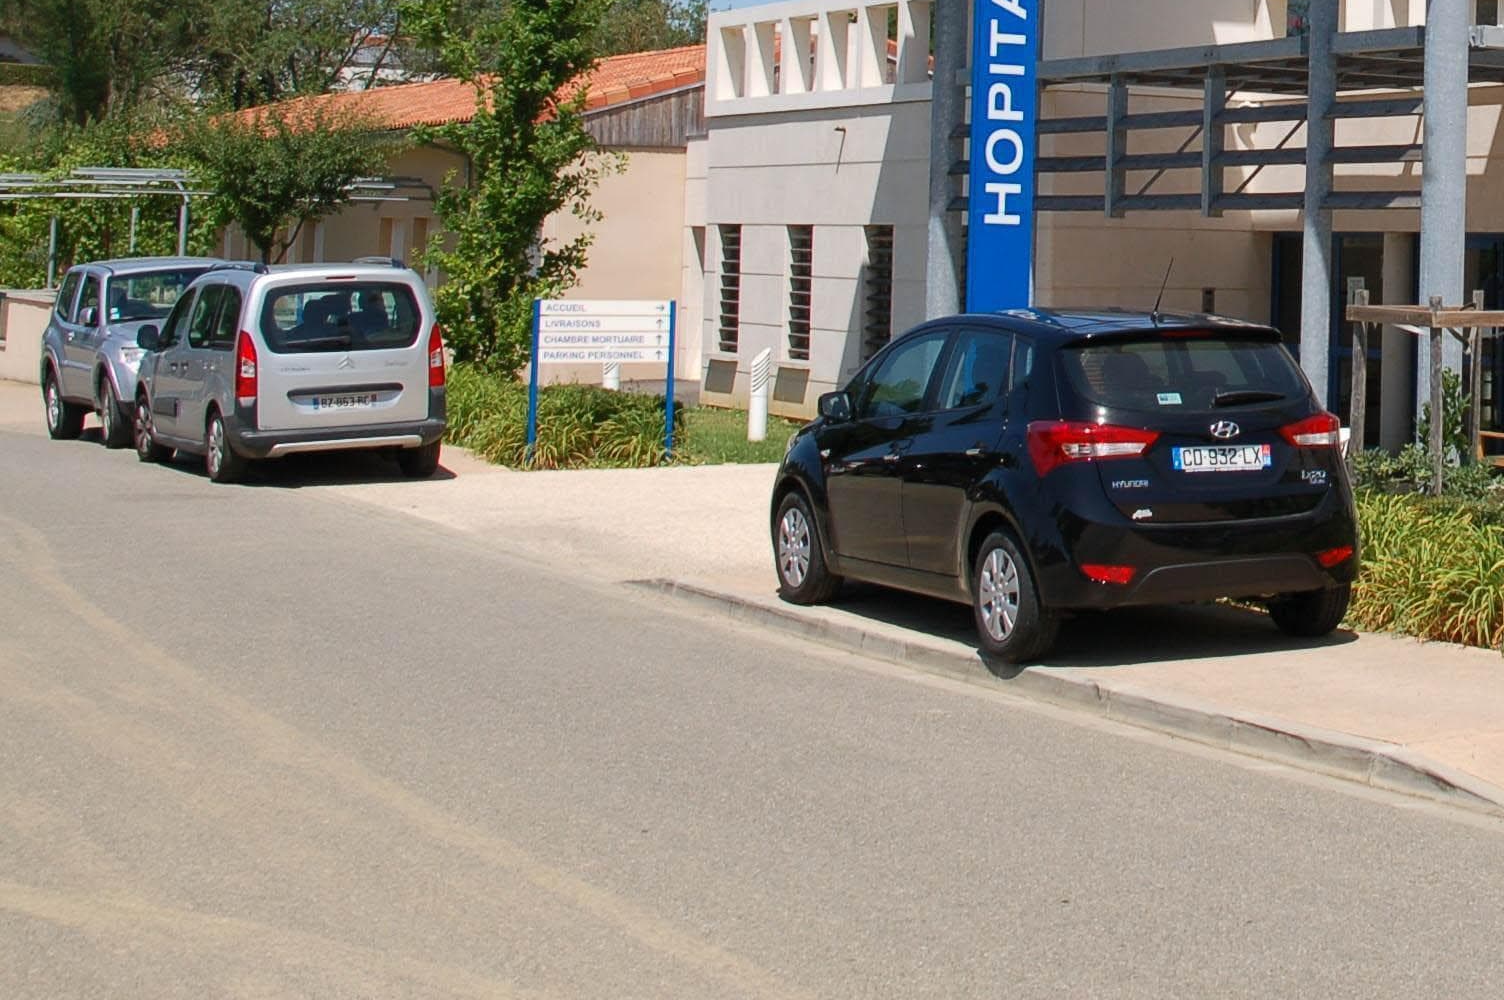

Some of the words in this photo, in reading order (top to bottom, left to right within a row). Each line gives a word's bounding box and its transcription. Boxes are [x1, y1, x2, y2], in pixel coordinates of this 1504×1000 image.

[545, 303, 587, 313] ACCUEIL
[545, 319, 601, 329] LIVRAISONS
[544, 335, 588, 344] CHAMBRE
[592, 335, 645, 344] MORTUAIRE
[543, 351, 585, 360] PARKING
[588, 351, 645, 360] PERSONNEL
